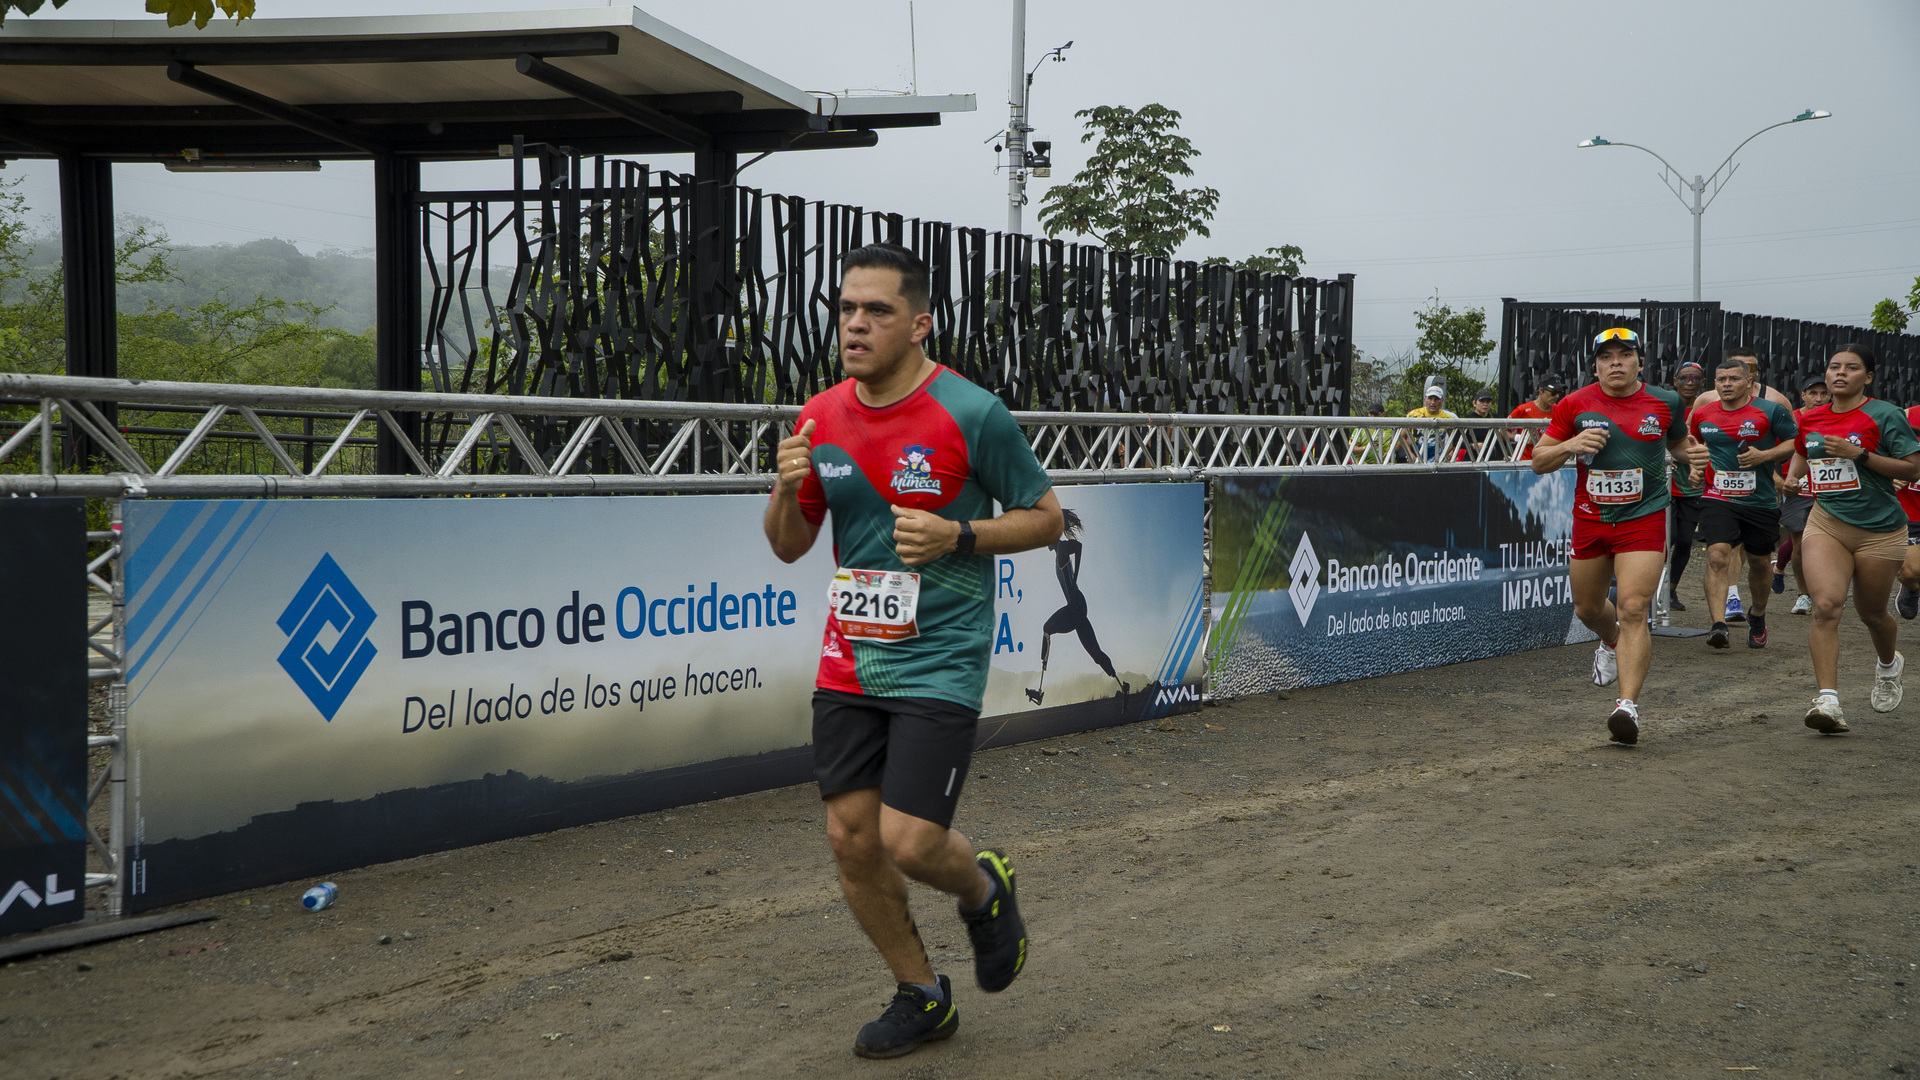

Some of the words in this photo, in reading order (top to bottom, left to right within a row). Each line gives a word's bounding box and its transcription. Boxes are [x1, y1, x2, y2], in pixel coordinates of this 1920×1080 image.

[890, 475, 941, 492] Muñeca
[1596, 480, 1633, 494] 1133
[1722, 479, 1744, 489] 955
[1819, 468, 1842, 482] 207
[1327, 558, 1376, 594] Banco
[1382, 554, 1402, 588] de
[1405, 551, 1481, 586] Occidente
[1500, 543, 1519, 573] TU
[840, 590, 900, 620] 2216
[1327, 613, 1346, 637] Del
[1348, 610, 1374, 634] lado
[1376, 607, 1390, 628] de
[1392, 604, 1408, 627] los
[1410, 608, 1430, 630] que
[1432, 602, 1466, 623] hacen.
[402, 600, 545, 660] Banco
[557, 590, 606, 645] de
[615, 582, 797, 640] Occidente
[403, 690, 455, 734] Del
[465, 683, 532, 726] lado
[540, 678, 576, 715] de
[584, 674, 621, 710] los
[630, 674, 677, 712] que
[685, 664, 763, 697] hacen.
[1155, 685, 1200, 707] AVAL
